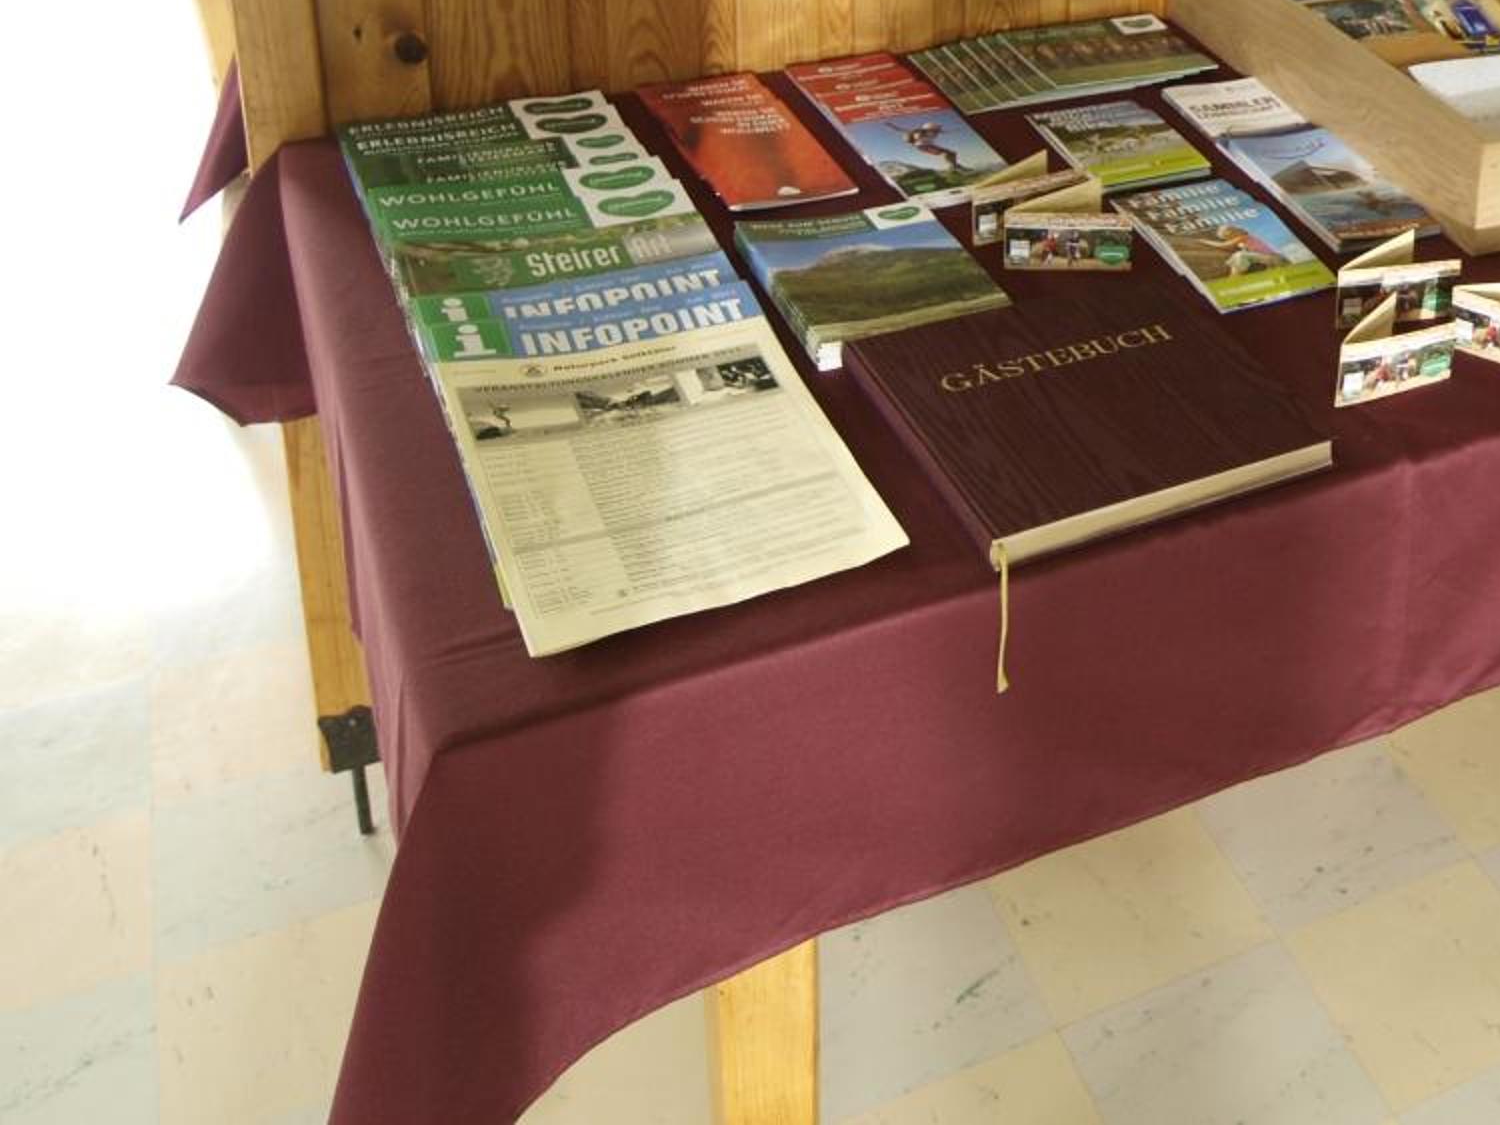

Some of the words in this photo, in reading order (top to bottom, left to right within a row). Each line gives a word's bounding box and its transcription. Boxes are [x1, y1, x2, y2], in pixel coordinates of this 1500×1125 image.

[349, 106, 504, 135] ERLEBNISREICH
[356, 122, 516, 151] ERLEBNISREICH
[378, 182, 561, 207] WOHLGEFÜHL
[1148, 196, 1240, 221] Familie
[391, 208, 577, 230] WOHLGEFÜHL
[1166, 208, 1260, 233] Familie
[526, 242, 622, 277] Steirer
[503, 269, 721, 318] INFOPOINT
[519, 299, 747, 357] INFOPOINT
[940, 324, 1173, 392] GÄSTEBUCH
